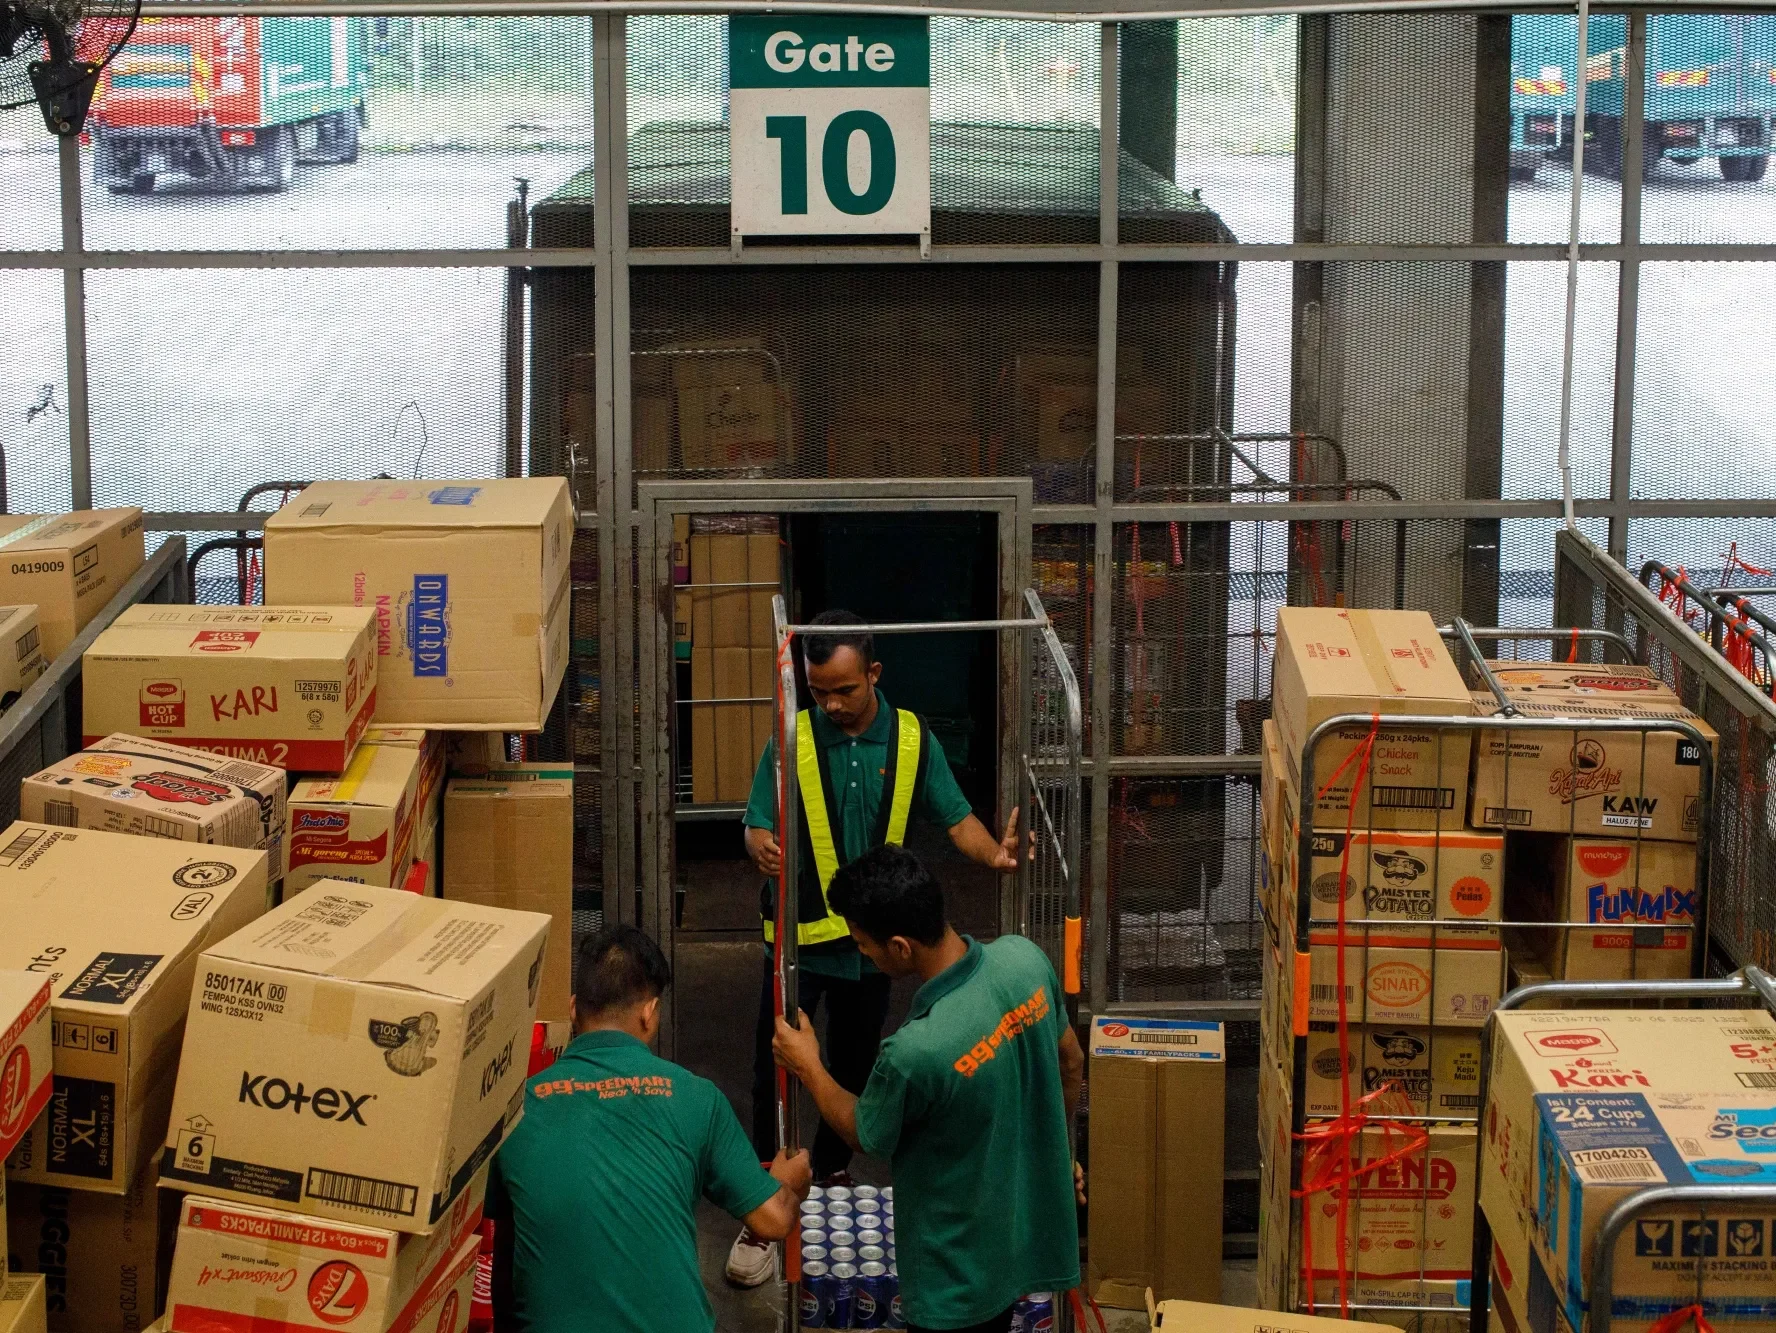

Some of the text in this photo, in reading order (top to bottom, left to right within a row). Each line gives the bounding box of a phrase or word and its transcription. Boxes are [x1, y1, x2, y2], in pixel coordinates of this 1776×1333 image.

[764, 31, 895, 73] Gate
[766, 109, 897, 216] 10
[12, 561, 65, 574] 0419009
[376, 595, 391, 656] NAPKIN
[418, 581, 441, 671] ONWARDS
[298, 683, 339, 691] 12579976
[211, 686, 278, 722] KARI
[323, 693, 339, 702] 58g)
[148, 705, 174, 715] HOT
[152, 714, 177, 724] CUP
[1339, 732, 1370, 740] Packin
[1375, 733, 1395, 743] 250g
[1403, 734, 1432, 743] 24pkts.
[1377, 748, 1418, 760] Chicken
[1380, 764, 1411, 775] Snack
[1593, 767, 1623, 792] Api
[261, 794, 273, 823] 40
[1603, 795, 1657, 814] KAW
[1606, 817, 1630, 825] HALUS
[300, 847, 312, 855] Mi
[313, 850, 349, 859] goreng
[1584, 852, 1622, 860] munchy's
[1363, 886, 1433, 914] POTATO
[1381, 888, 1430, 897] MISTER
[1456, 892, 1483, 901] Pedas
[177, 897, 206, 915] VAL
[1602, 937, 1629, 948] 900g
[69, 958, 115, 995] NORMAL
[96, 968, 135, 989] XL
[205, 972, 285, 1000] 85017AK 00
[1373, 978, 1419, 991] SINAR
[203, 990, 284, 1014] FEMPAD KSS OVN32
[201, 1001, 264, 1022] WING 12SX3X12
[953, 1040, 995, 1077] 99
[1143, 1050, 1200, 1058] FAMILYPACKS
[1382, 1069, 1429, 1077] MISTER
[1454, 1073, 1476, 1081] Madu
[1457, 1066, 1474, 1074] Keju
[1549, 1069, 1651, 1088] Kari
[534, 1076, 672, 1098] 99 SPEEDMART
[599, 1087, 672, 1099] Near Save
[1575, 1098, 1635, 1106] Content:
[1551, 1106, 1646, 1123] 24 Cups
[52, 1087, 69, 1162] NORMAL
[71, 1110, 96, 1148] XL
[100, 1112, 110, 1146] (8s+1s)
[188, 1136, 203, 1157] 6
[99, 1149, 108, 1167] 54s
[183, 1157, 204, 1165] MAXIMUM
[1574, 1149, 1648, 1163] 17004203
[182, 1162, 204, 1171] STACKING
[221, 1215, 309, 1242] FAMILYPACKS
[312, 1230, 327, 1244] 12
[336, 1233, 356, 1248] 60g
[241, 1256, 256, 1264] krim
[258, 1258, 280, 1267] dengan
[1711, 1262, 1767, 1270] STACKING
[198, 1265, 297, 1292] Croissant x4
[120, 1264, 137, 1311] 30073D
[312, 1268, 343, 1310] DAYS
[320, 1266, 356, 1316] 7
[1360, 1289, 1395, 1298] NON-SPILL
